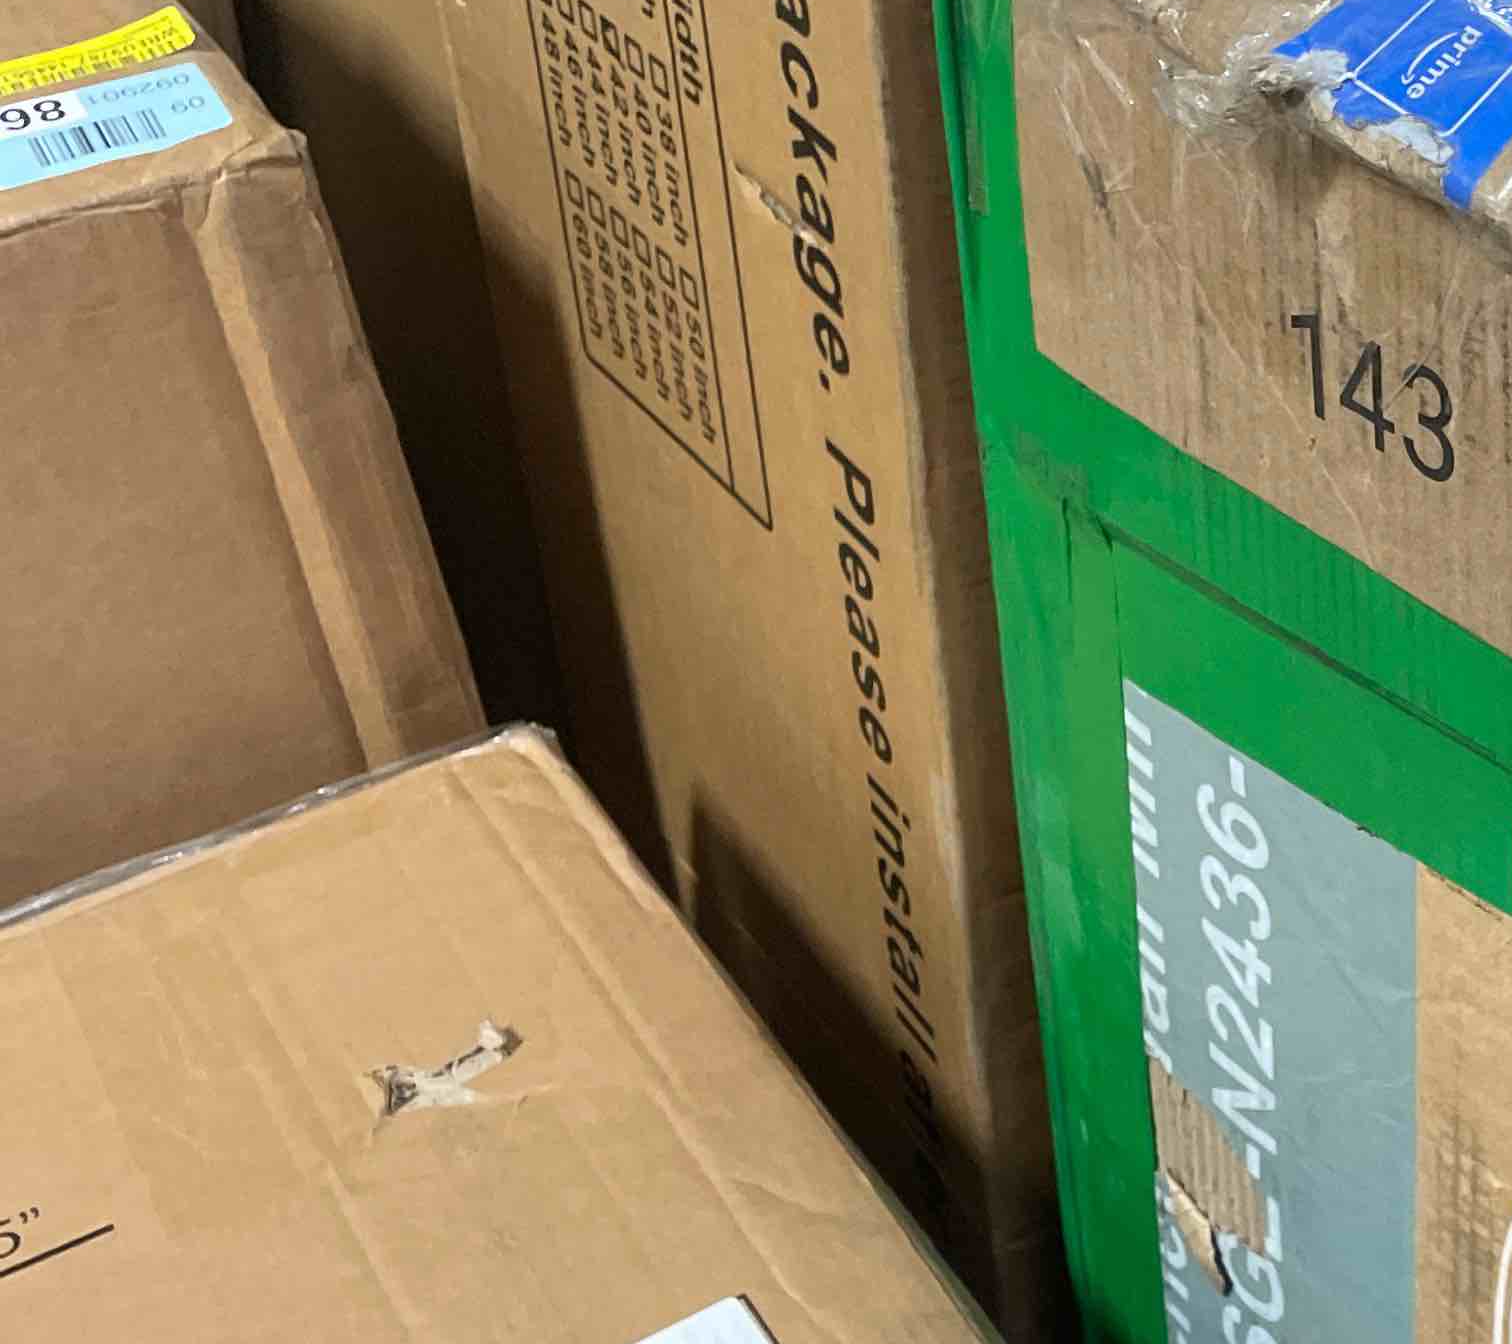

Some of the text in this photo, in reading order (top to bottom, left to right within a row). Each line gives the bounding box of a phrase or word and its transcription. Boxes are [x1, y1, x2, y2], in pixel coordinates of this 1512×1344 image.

[583, 42, 606, 102] 44
[1405, 24, 1484, 102] prime
[654, 99, 676, 159] 38
[1290, 314, 1456, 483] 143
[825, 436, 893, 766] Please
[867, 772, 938, 1063] install
